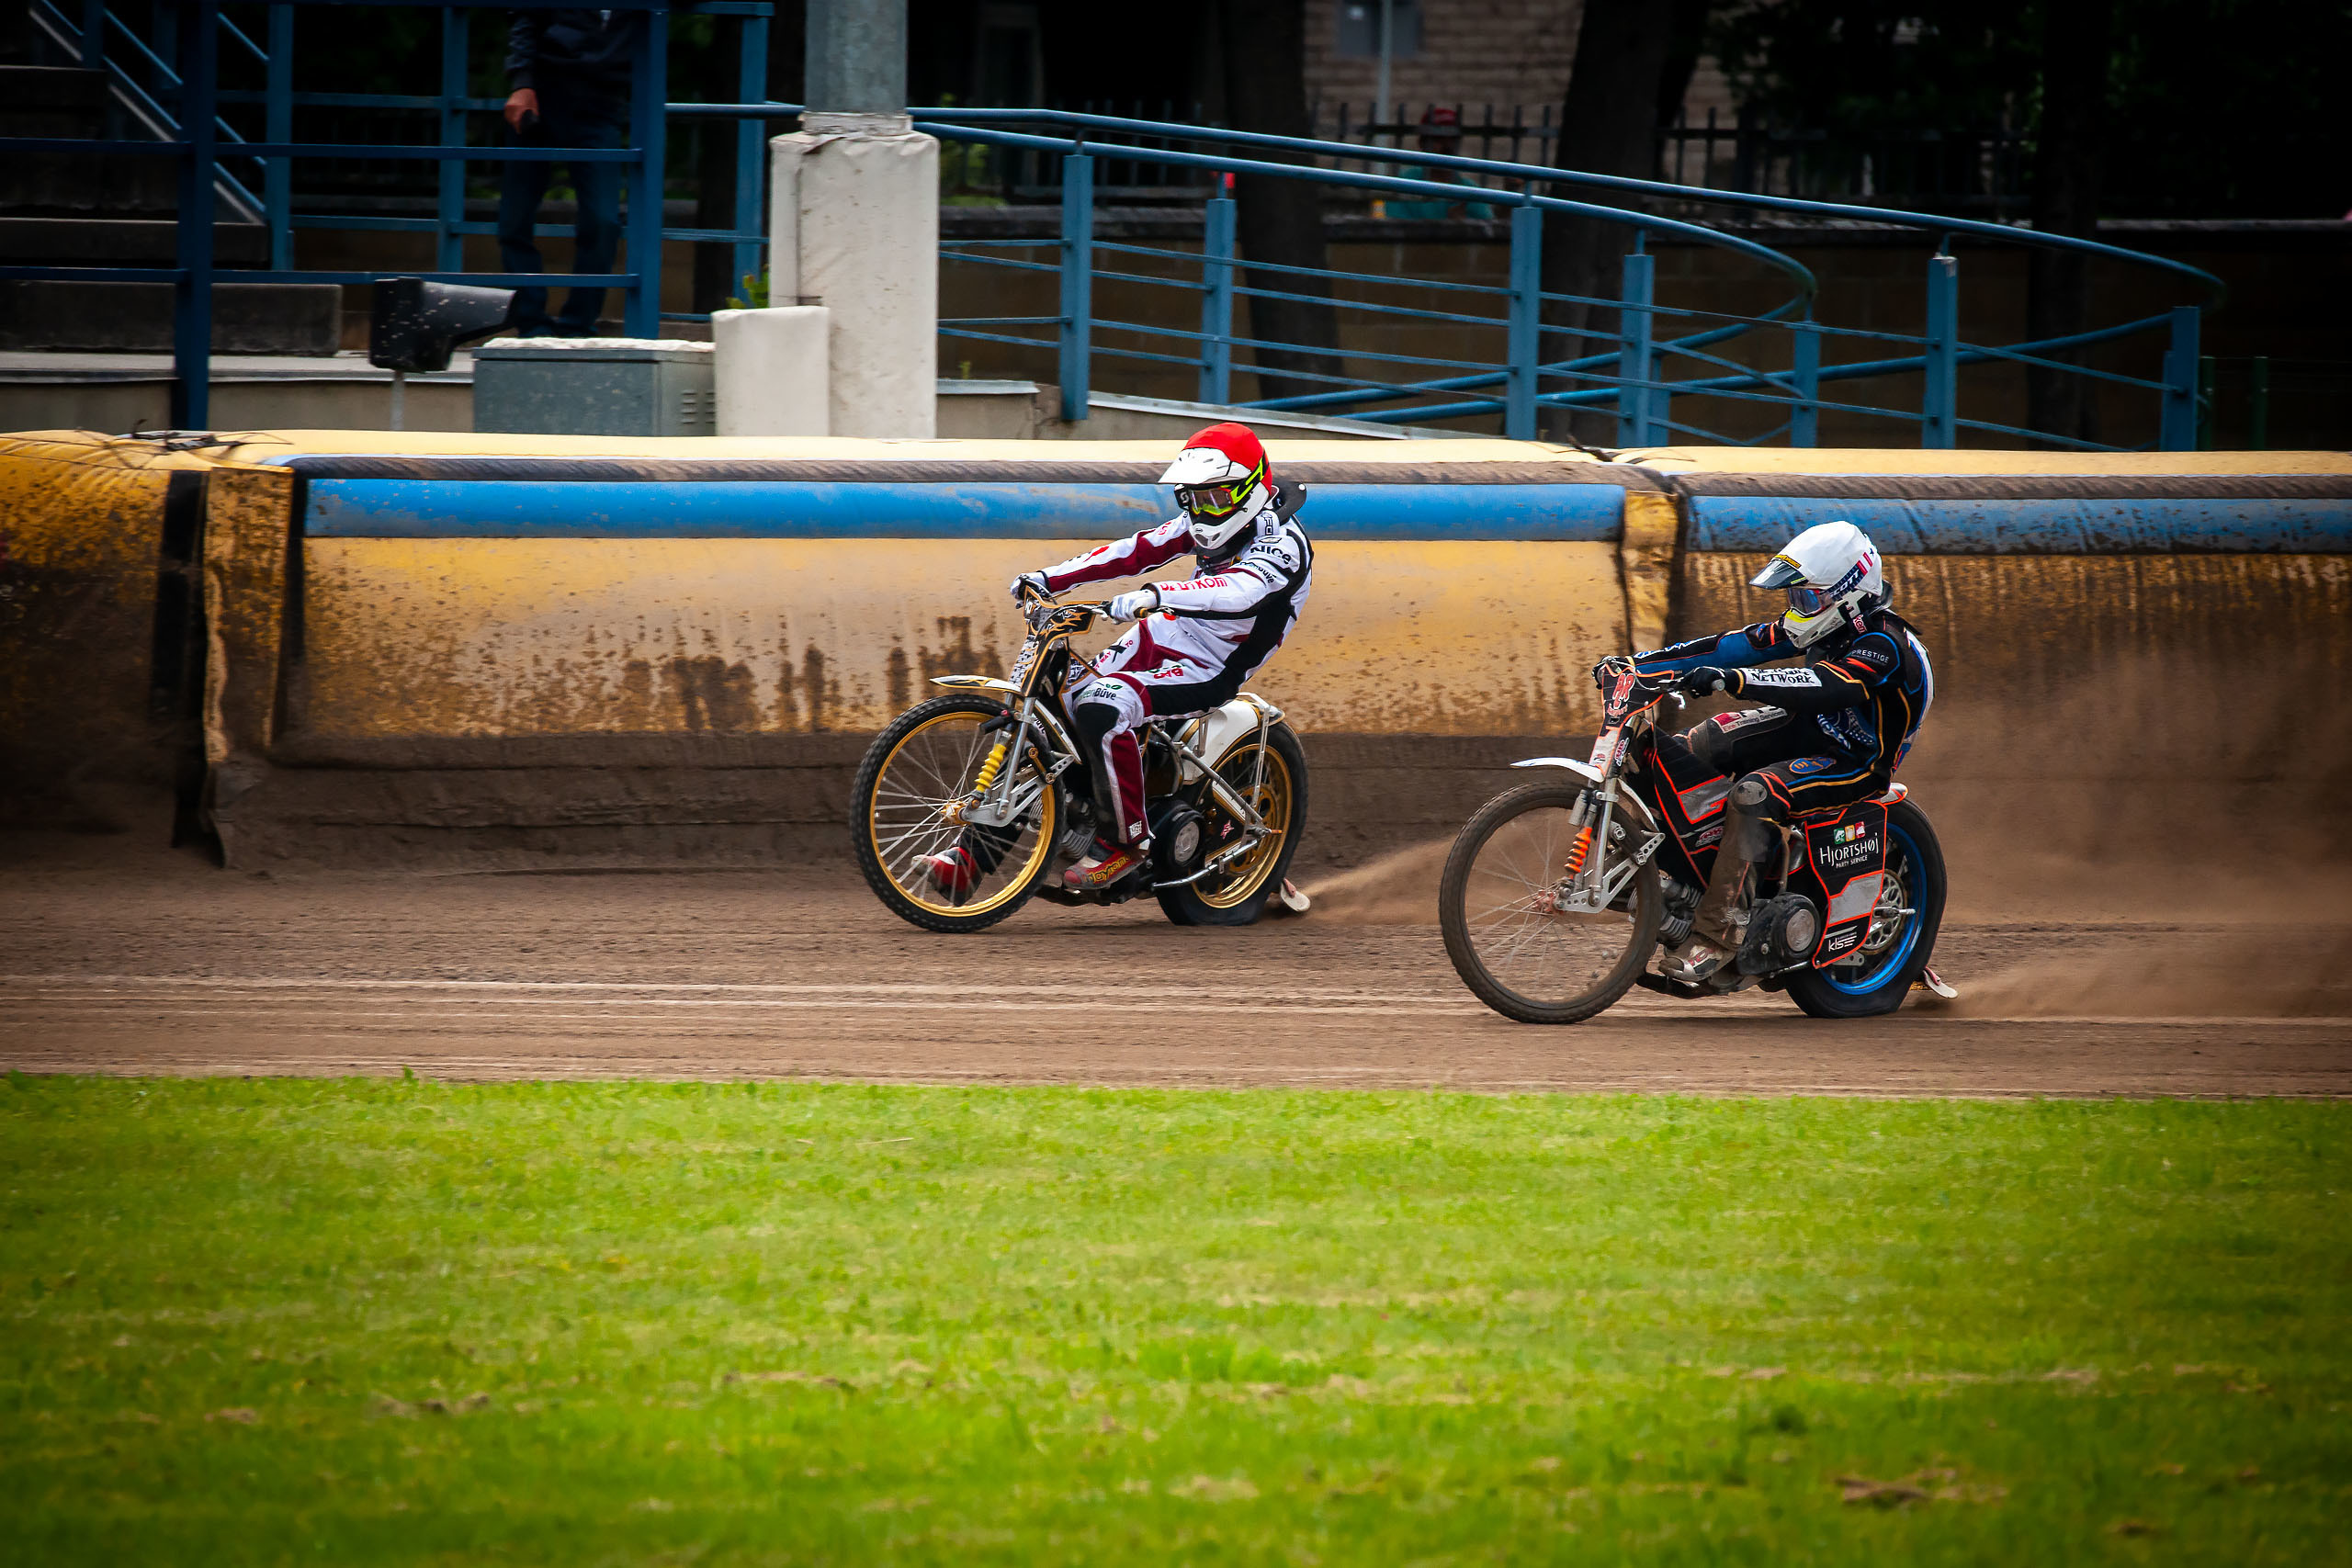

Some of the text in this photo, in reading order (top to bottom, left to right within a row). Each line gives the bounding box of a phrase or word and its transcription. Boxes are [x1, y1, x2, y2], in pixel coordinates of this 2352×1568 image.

[1829, 569, 1860, 598] SCOTT
[1851, 649, 1890, 663] PRESTIGE
[1751, 672, 1815, 684] NETWORK
[1836, 854, 1868, 869] PARTY SERVICE
